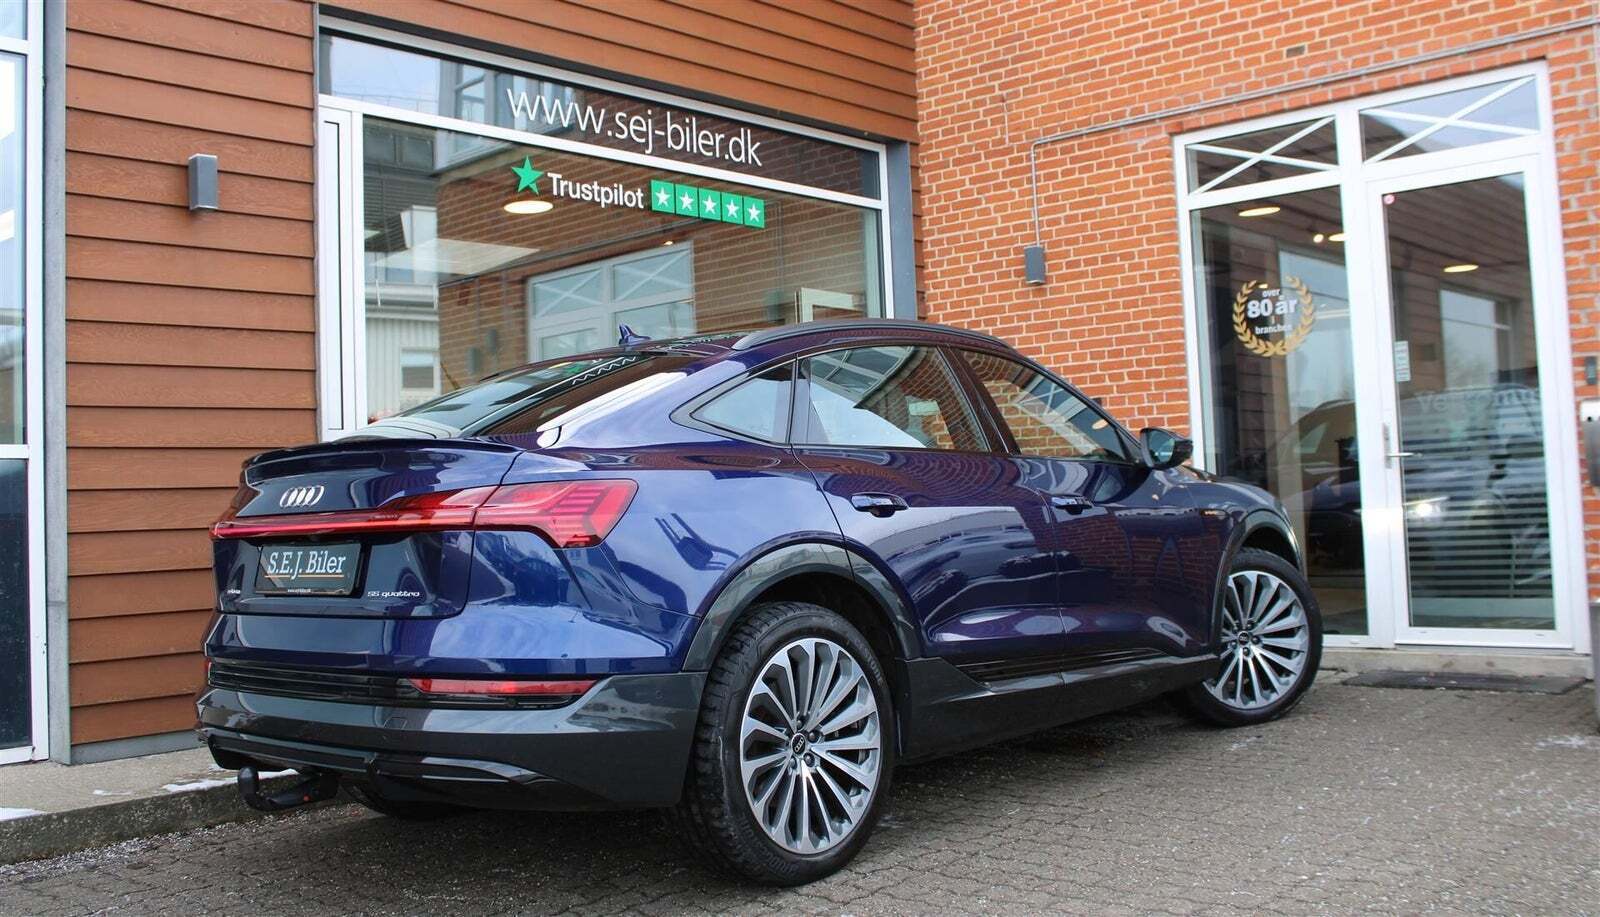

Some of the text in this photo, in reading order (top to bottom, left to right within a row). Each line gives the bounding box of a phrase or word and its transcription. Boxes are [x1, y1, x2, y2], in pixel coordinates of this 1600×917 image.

[507, 88, 763, 167] www.sej-biler.dk
[547, 172, 644, 209] Trustpilot
[1247, 295, 1297, 318] 80 år
[1263, 289, 1280, 298] over
[267, 549, 346, 580] S.E.J. Biler
[381, 590, 420, 598] quattro
